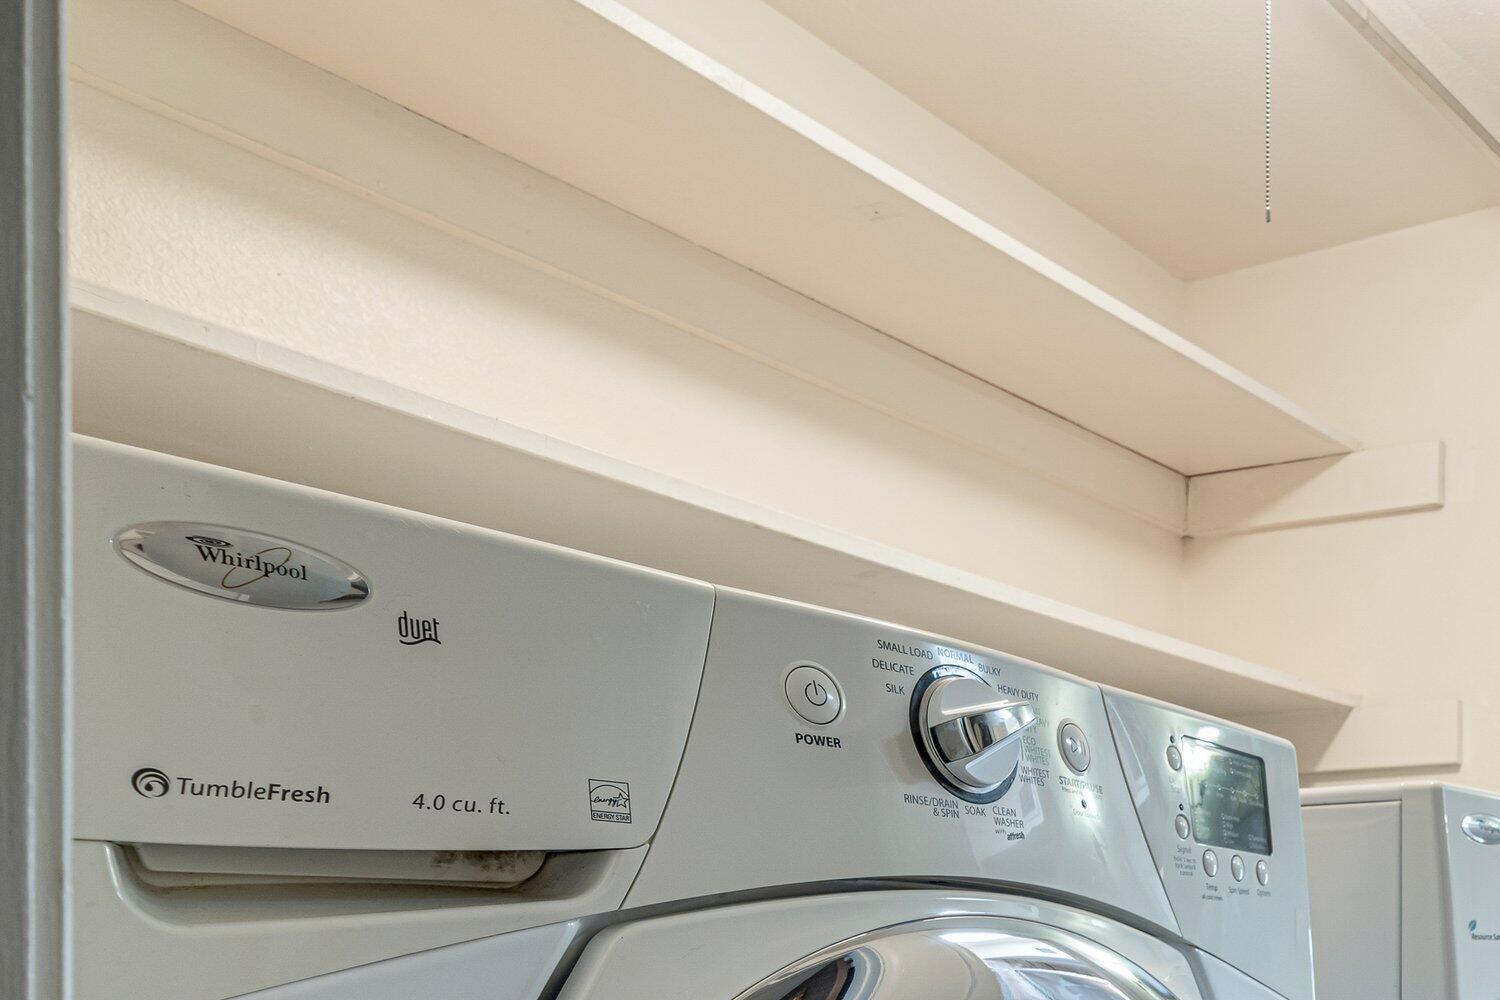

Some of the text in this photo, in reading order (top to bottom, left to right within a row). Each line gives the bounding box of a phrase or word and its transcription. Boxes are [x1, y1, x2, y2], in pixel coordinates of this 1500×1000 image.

[195, 544, 308, 581] Whirlpool
[398, 611, 441, 645] duet
[877, 639, 934, 660] SMALL LOAD
[937, 647, 975, 664] NORMAL
[872, 658, 915, 676] DELICATE
[978, 663, 1001, 677] BULKY
[885, 683, 906, 696] SILK
[997, 684, 1039, 701] HEAVY DUTY
[795, 733, 842, 749] POWER
[1019, 773, 1045, 787] WHITES
[1021, 765, 1050, 779] WHITEST
[177, 777, 330, 804] TumbleFresh
[412, 793, 510, 815] 4.0 cu. ft.
[903, 793, 959, 809] RINSE/DRAIN
[593, 812, 614, 820] ENERGY
[933, 807, 960, 819] & SPIN
[964, 805, 987, 817] SOAK
[992, 805, 1017, 818] CLEAN
[993, 816, 1025, 829] WASHER
